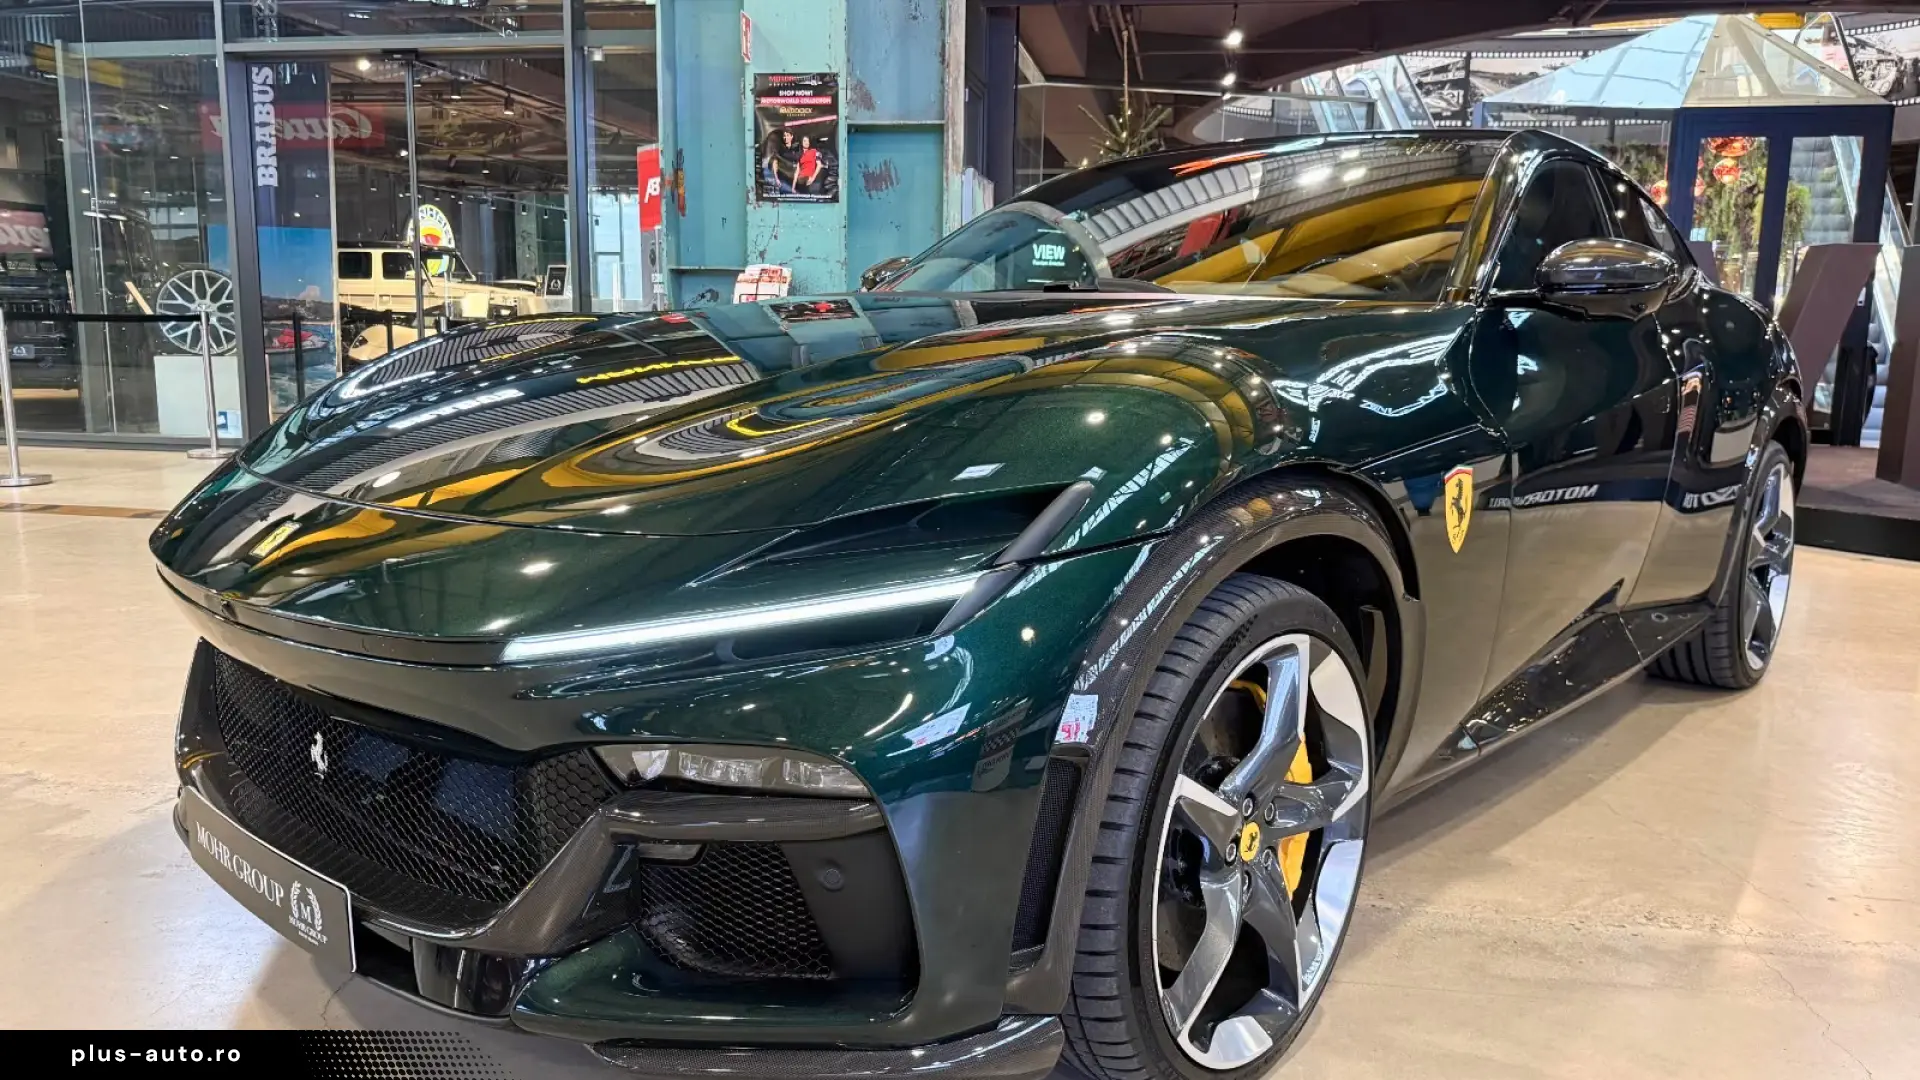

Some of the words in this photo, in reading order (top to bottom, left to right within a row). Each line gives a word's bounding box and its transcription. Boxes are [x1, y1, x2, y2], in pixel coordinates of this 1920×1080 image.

[251, 66, 279, 187] BRABUS
[644, 176, 661, 204] AB
[1032, 243, 1065, 260] VIEW
[196, 821, 233, 872] MOHR
[233, 854, 284, 908] GROUP
[300, 901, 312, 924] M
